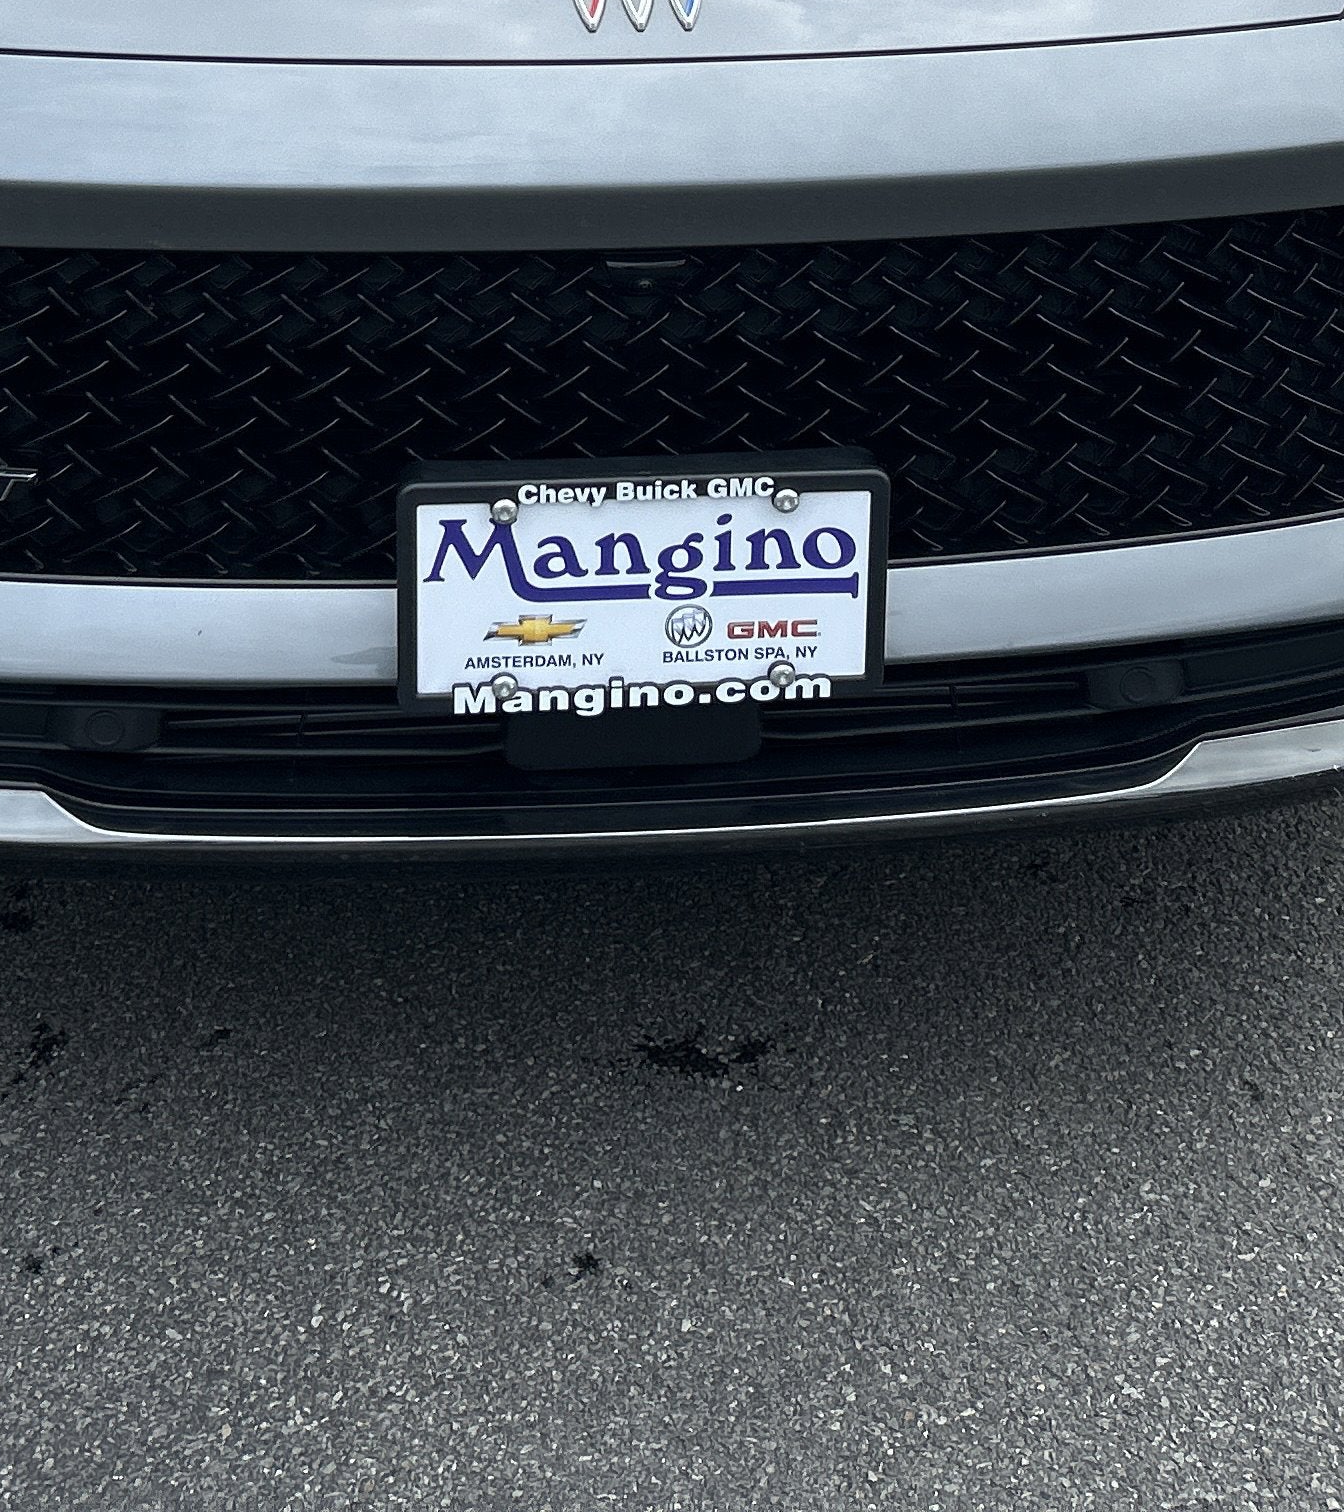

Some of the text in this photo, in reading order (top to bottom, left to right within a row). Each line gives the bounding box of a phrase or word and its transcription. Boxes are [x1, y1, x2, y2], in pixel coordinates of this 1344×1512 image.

[517, 476, 775, 508] Chevy Buick GMC
[423, 513, 859, 602] Mangino
[727, 619, 818, 640] GMC
[464, 652, 605, 670] AMSTERDAM, NY
[662, 645, 818, 664] BALLSTON SPA, NY
[453, 676, 832, 717] Mangino.com
